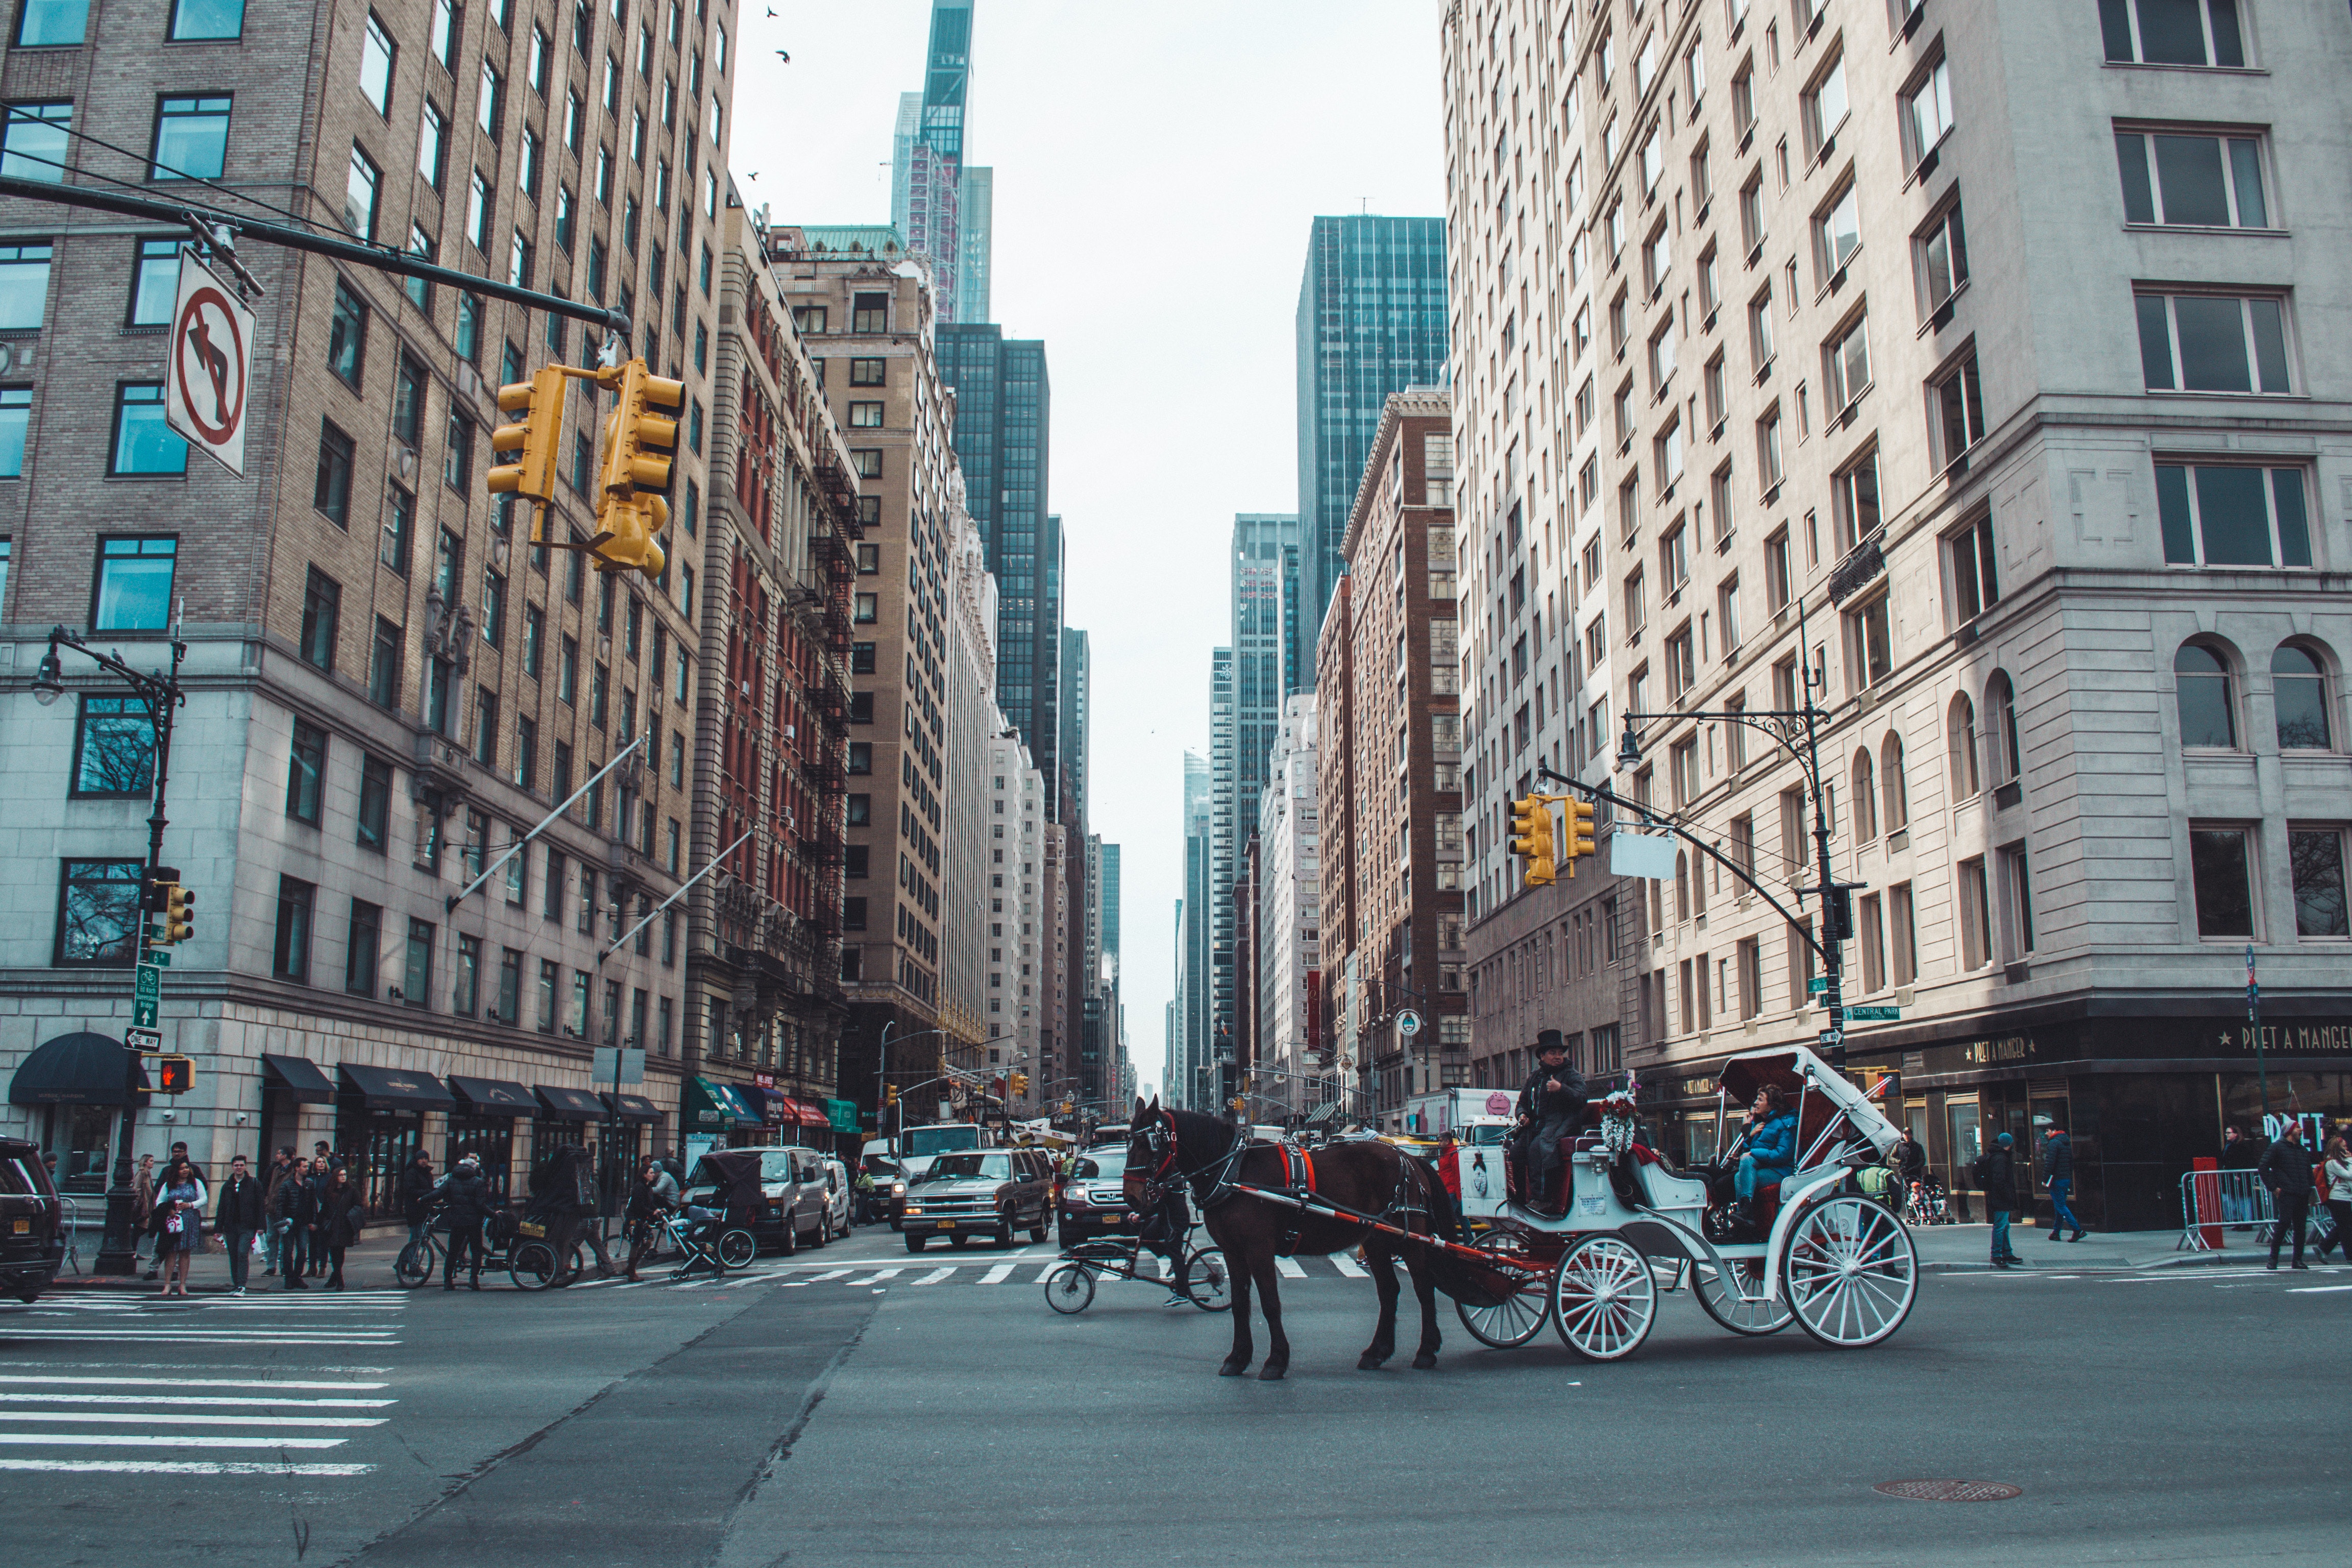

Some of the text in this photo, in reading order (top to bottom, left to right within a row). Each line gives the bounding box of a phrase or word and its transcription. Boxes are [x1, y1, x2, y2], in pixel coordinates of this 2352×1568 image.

[154, 952, 158, 963] 6
[1853, 1007, 1899, 1015] CENTRAL PARK
[131, 1035, 157, 1046] ONE WAY
[1830, 1032, 1839, 1041] WAY
[2284, 1027, 2293, 1049] A
[1974, 1037, 2025, 1063] PRET A MANGER
[2266, 1113, 2324, 1152] PET
